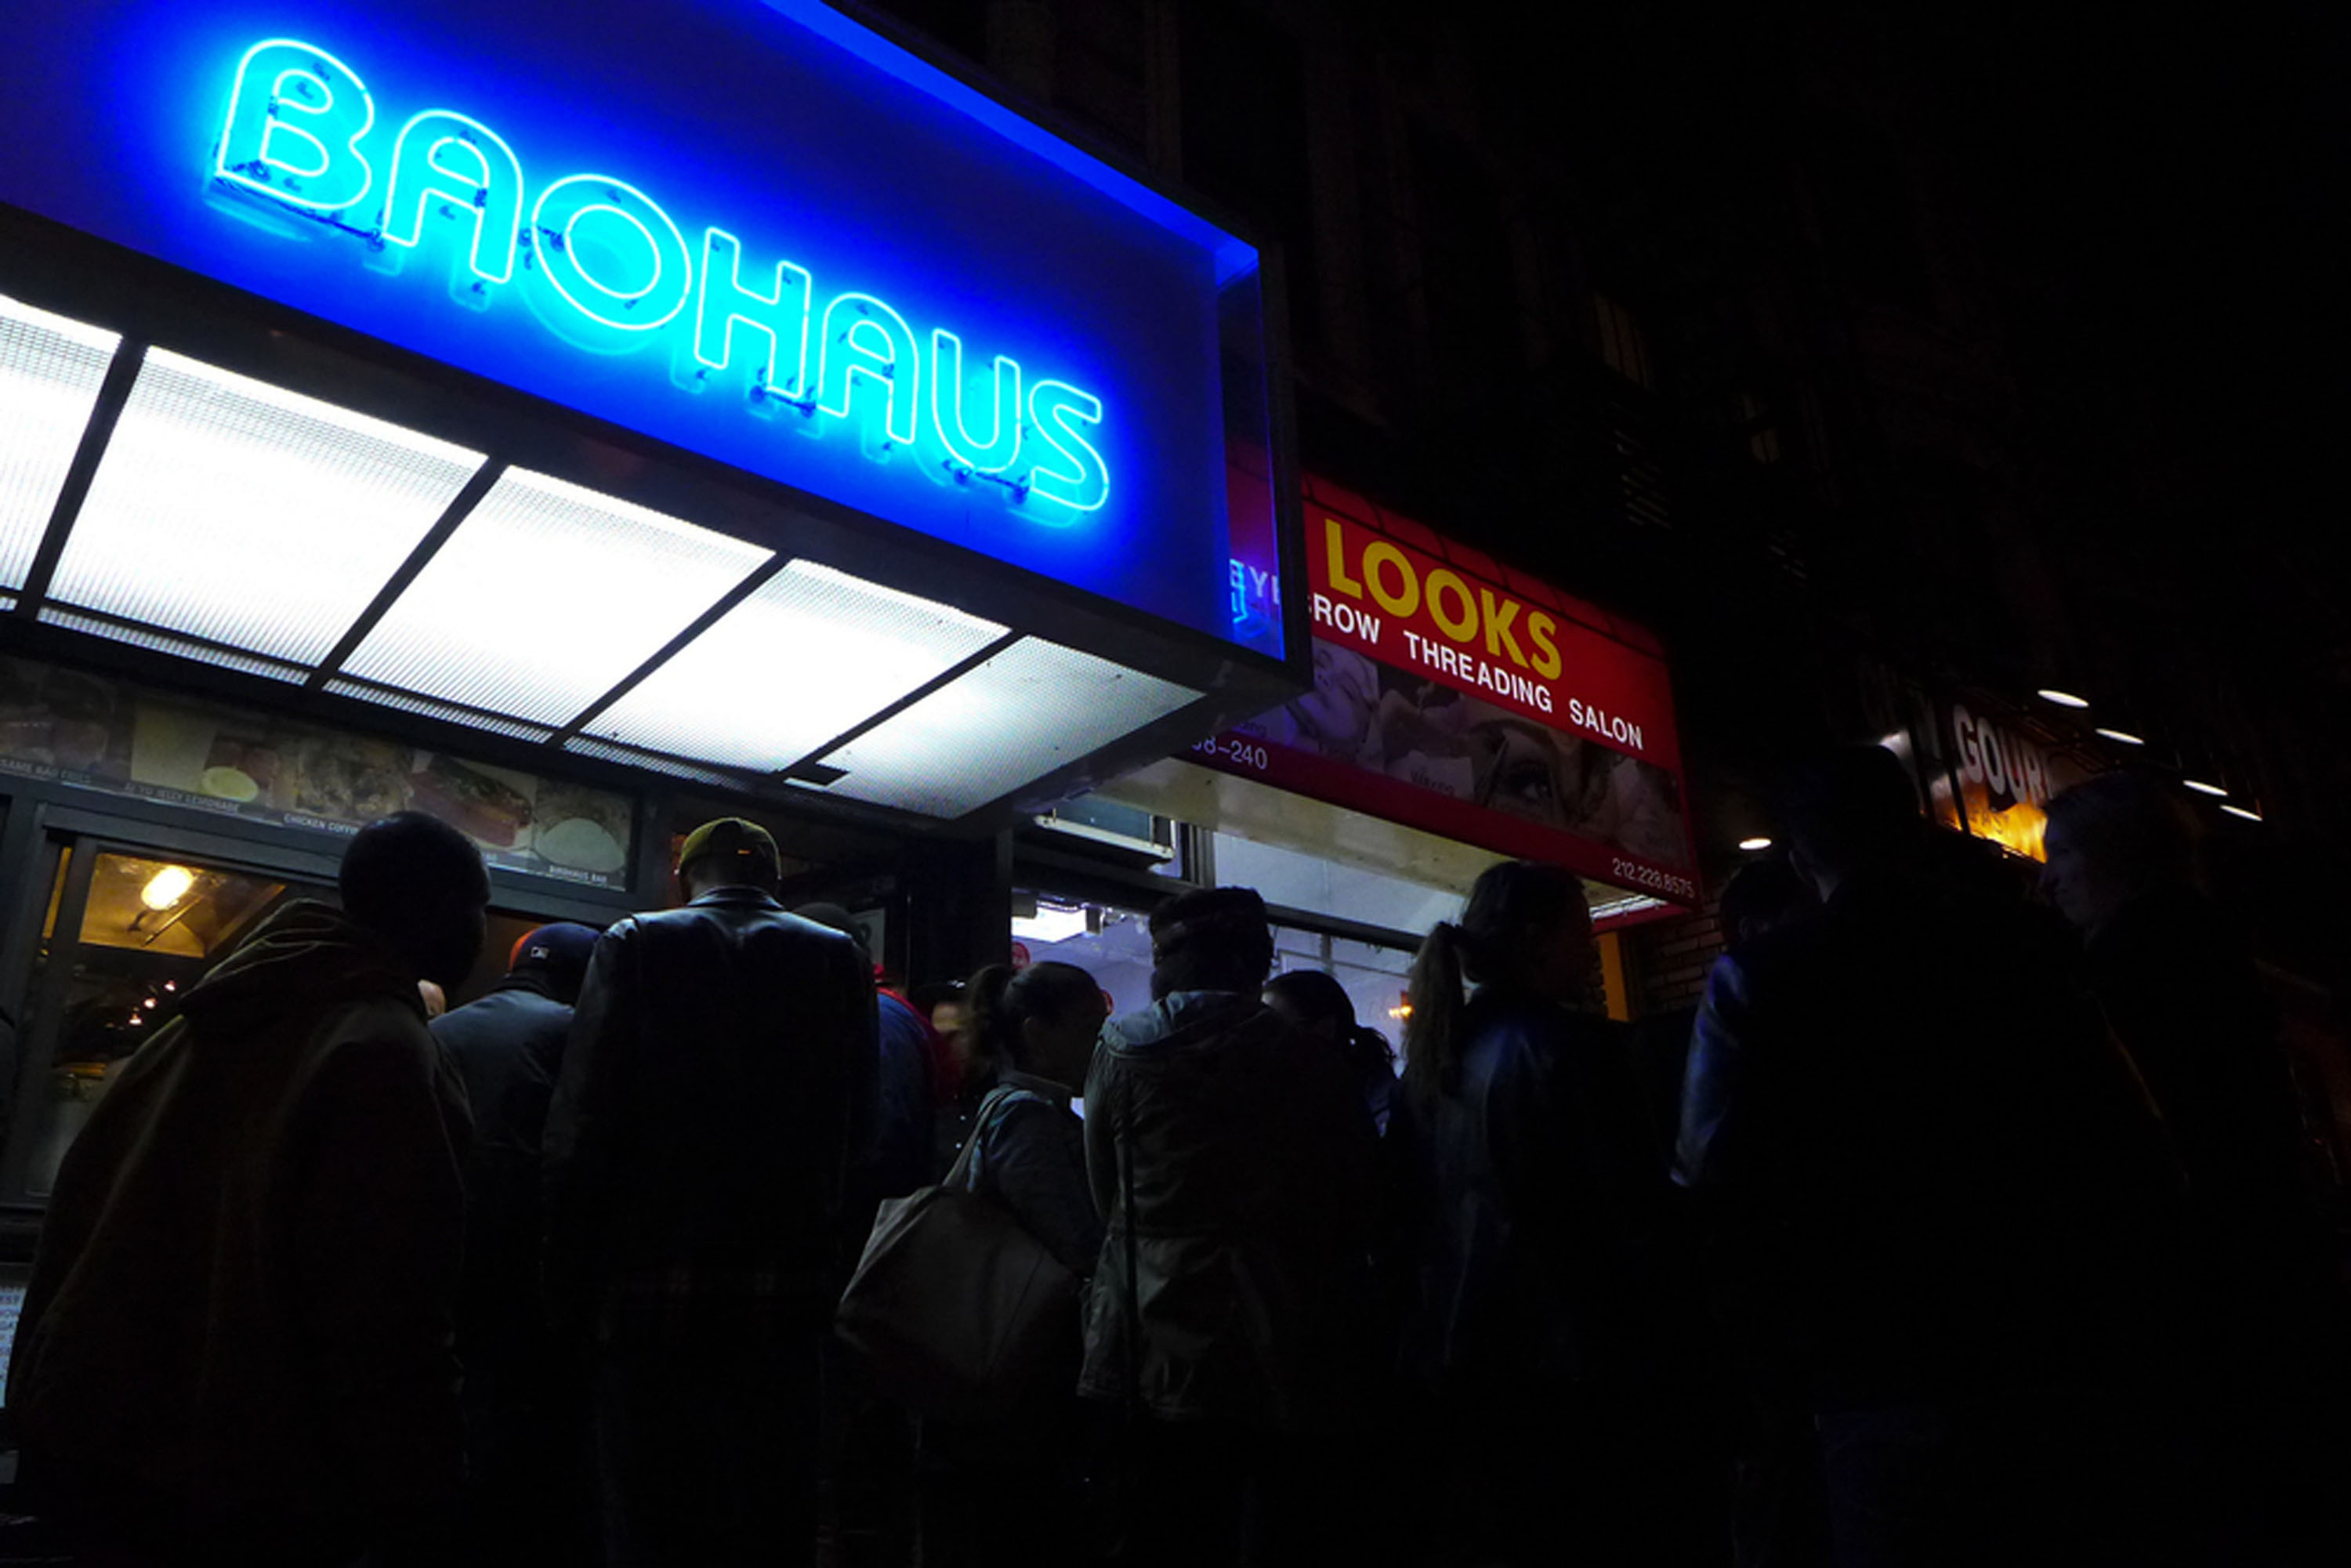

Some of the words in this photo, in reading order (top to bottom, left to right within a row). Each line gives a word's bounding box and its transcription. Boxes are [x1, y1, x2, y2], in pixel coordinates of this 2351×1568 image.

[213, 38, 1110, 512] BAOHAUS
[1324, 517, 1563, 681] LOOKS
[1403, 629, 1553, 714] THREADING
[1568, 697, 1643, 751] SALON
[284, 813, 325, 830] CHICKEN
